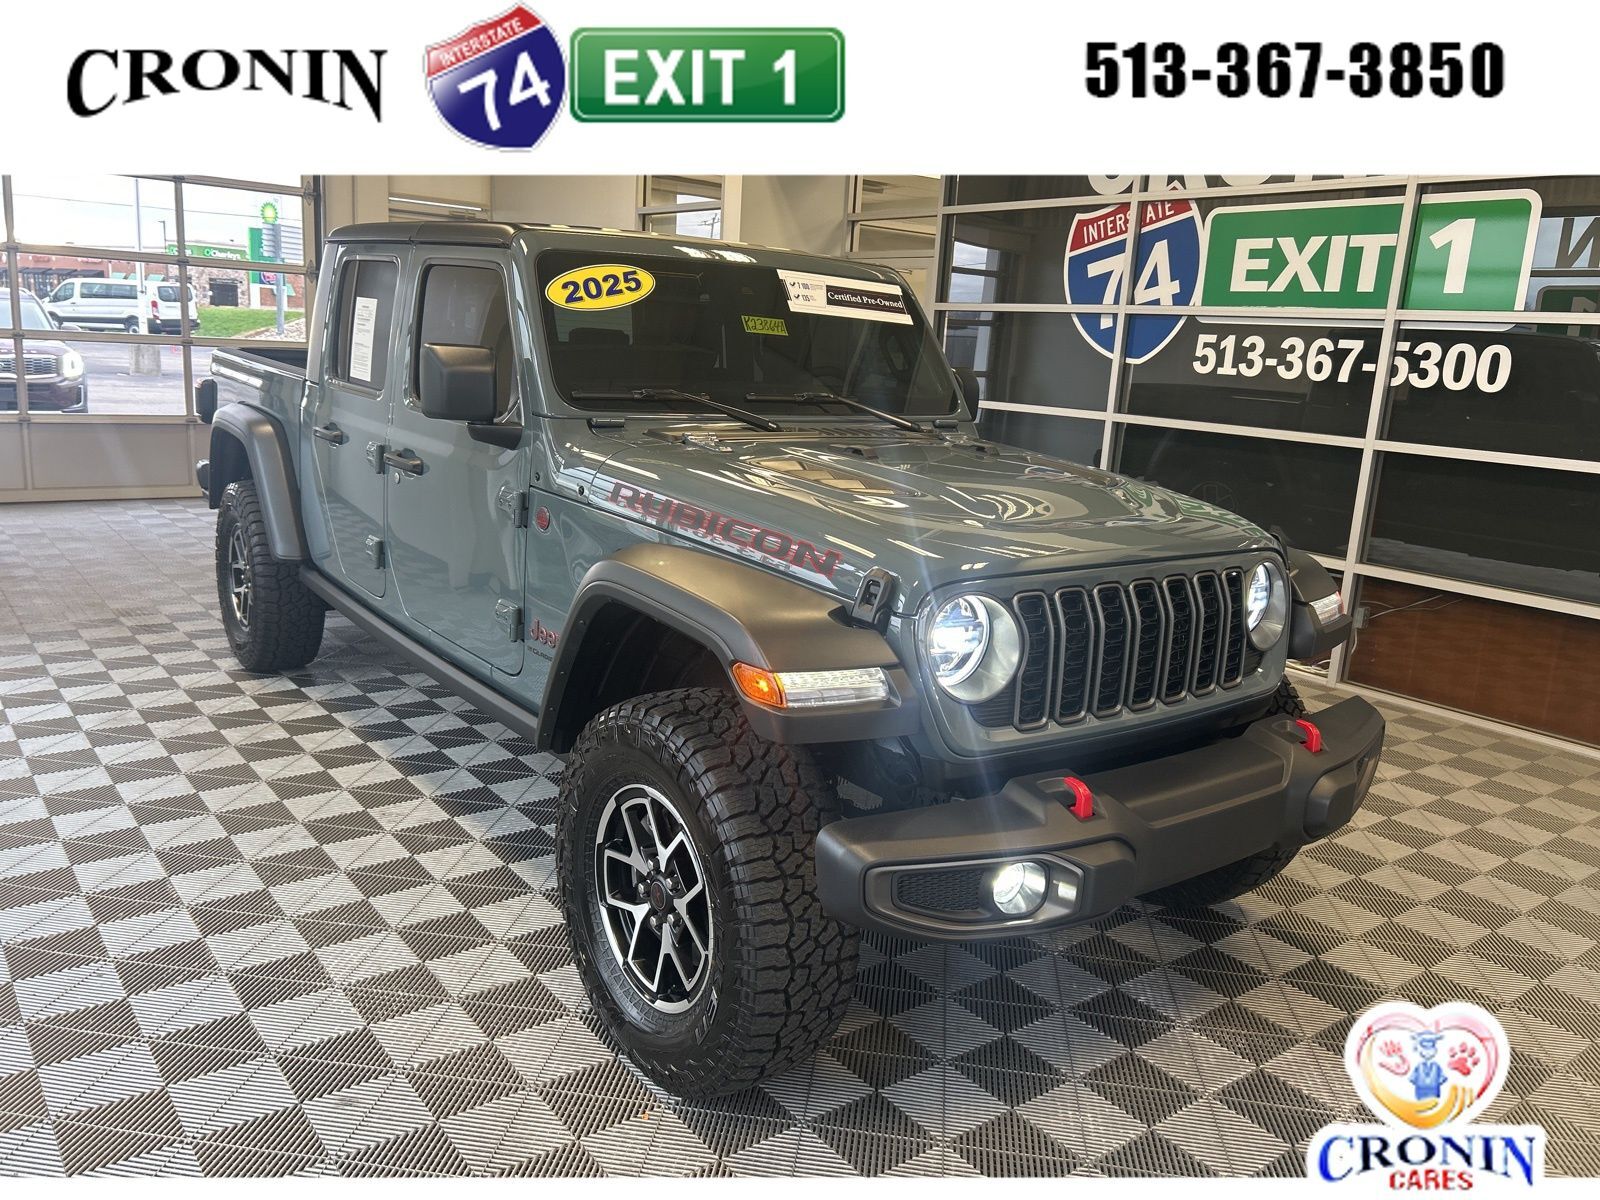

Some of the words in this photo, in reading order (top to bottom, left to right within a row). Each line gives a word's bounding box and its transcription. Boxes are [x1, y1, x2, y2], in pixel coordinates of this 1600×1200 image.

[1083, 200, 1175, 245] INTERATE
[1087, 239, 1181, 330] 74
[1229, 233, 1398, 293] EXIT
[1428, 217, 1476, 294] 1
[560, 270, 643, 304] 2025
[827, 291, 862, 303] Certified
[862, 296, 903, 309] Pre-Owned
[1193, 333, 1512, 394] 513-367-5300
[609, 481, 842, 578] RUBICON
